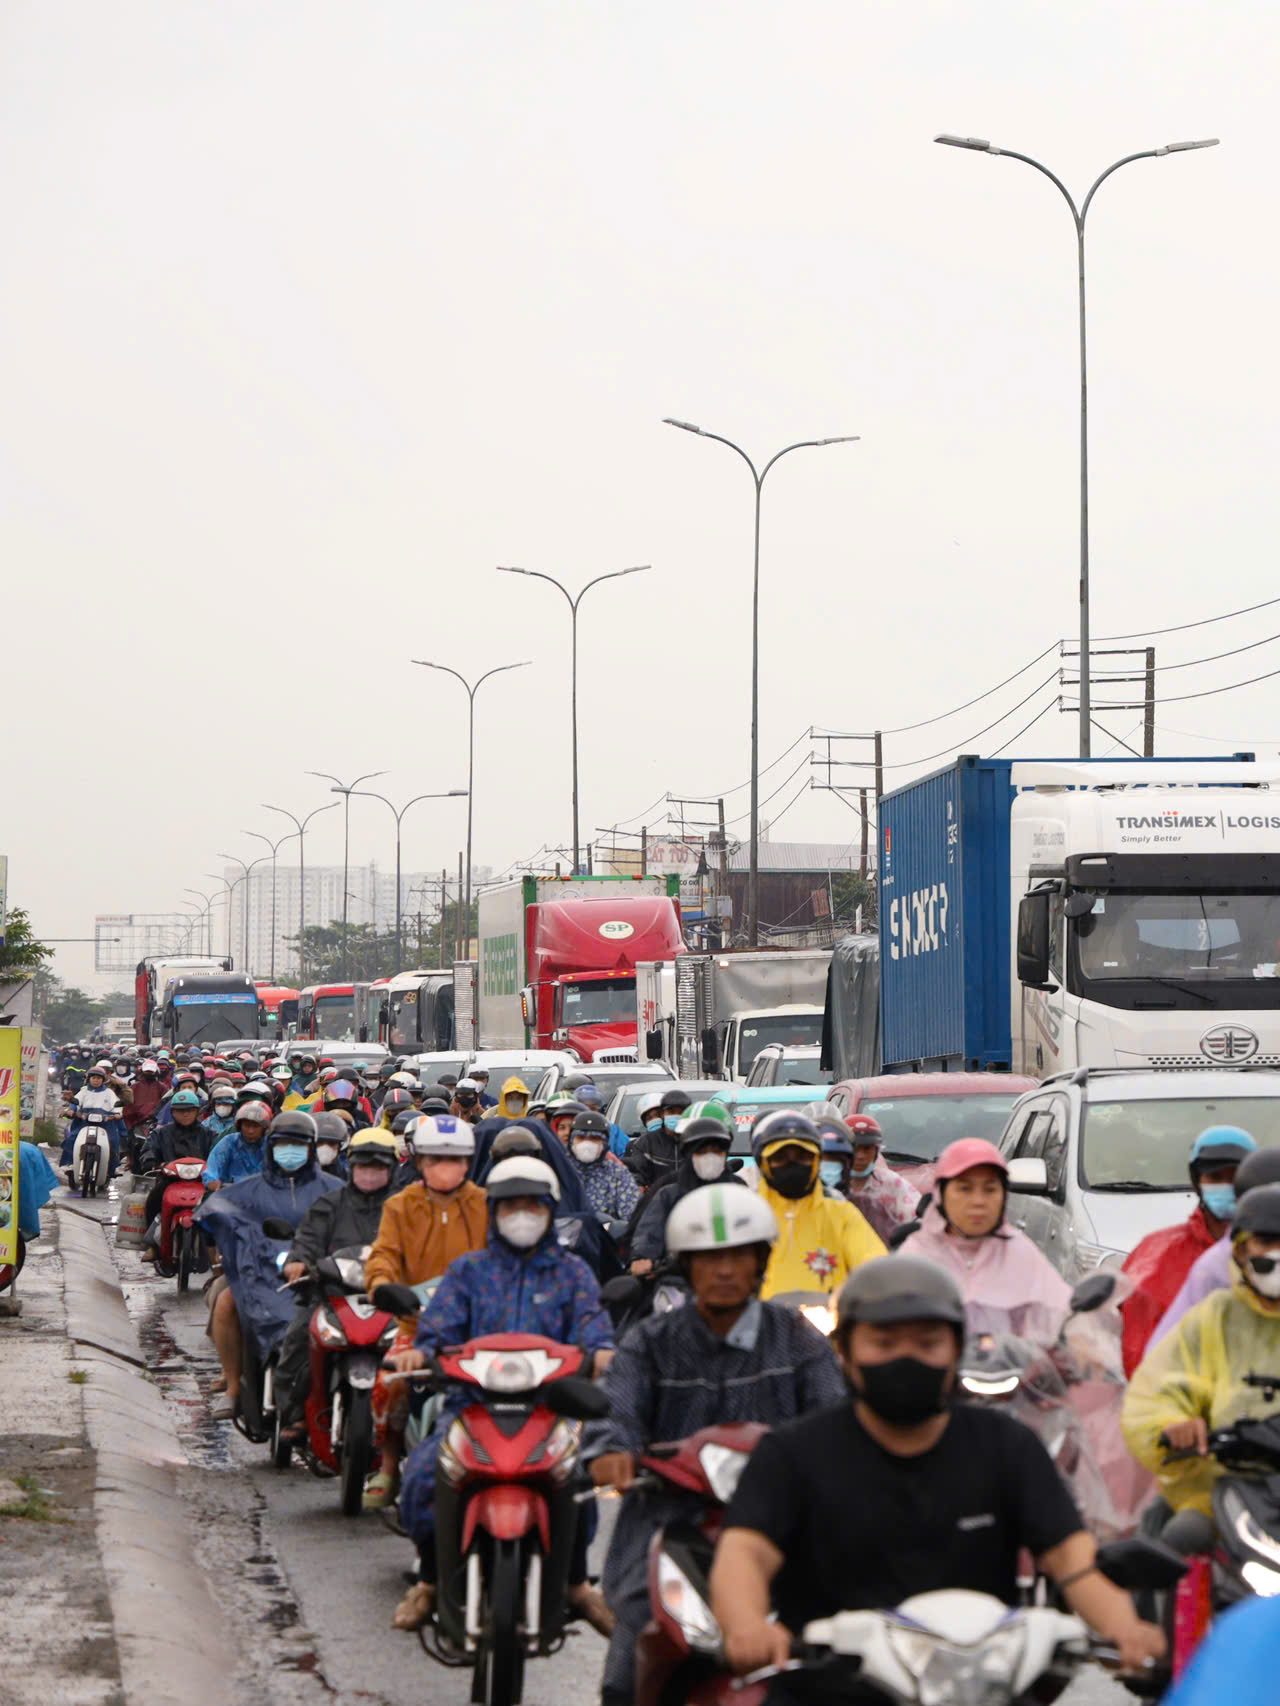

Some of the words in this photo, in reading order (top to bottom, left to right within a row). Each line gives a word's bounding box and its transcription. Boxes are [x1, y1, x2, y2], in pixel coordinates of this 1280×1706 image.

[1116, 812, 1217, 829] TRANSIMEX
[1121, 834, 1151, 844] Simply
[1154, 833, 1182, 843] Better
[605, 924, 630, 932] SP
